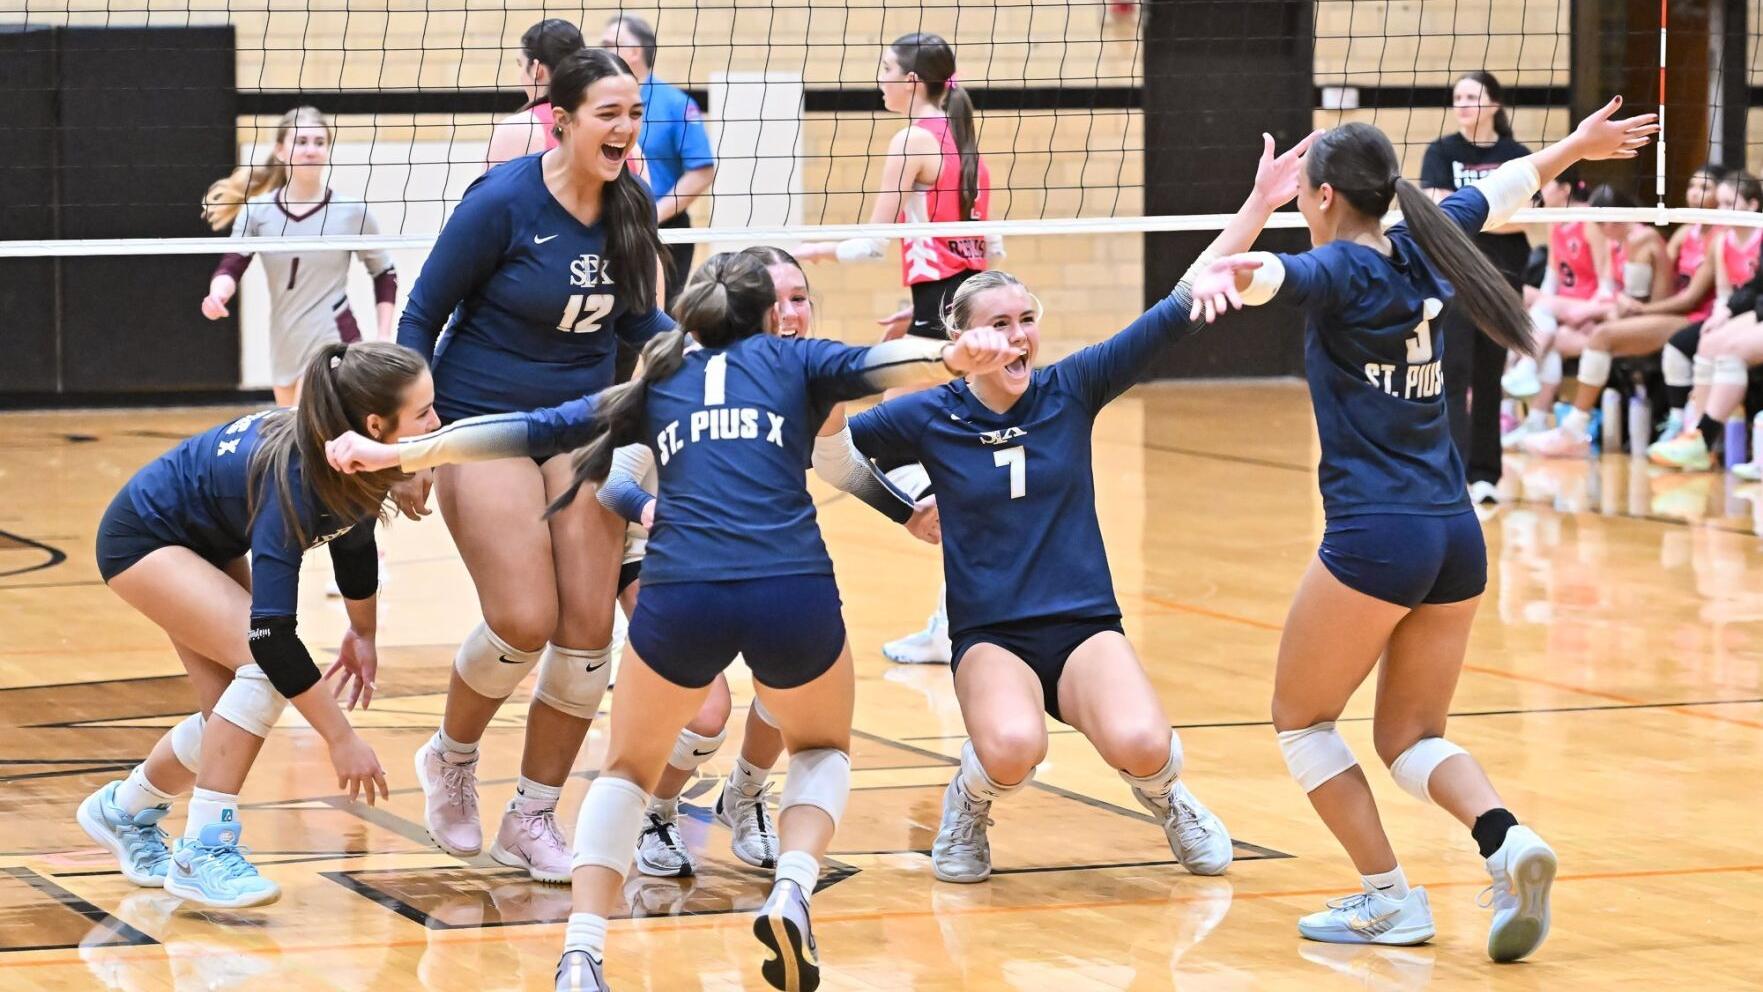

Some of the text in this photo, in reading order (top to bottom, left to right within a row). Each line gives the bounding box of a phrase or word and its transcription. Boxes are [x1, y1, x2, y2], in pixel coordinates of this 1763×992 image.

[287, 256, 300, 290] 1
[556, 294, 615, 333] 12
[704, 351, 727, 406] 1
[1364, 362, 1399, 398] ST.
[657, 408, 785, 466] ST. PIUS X
[993, 445, 1026, 500] 7
